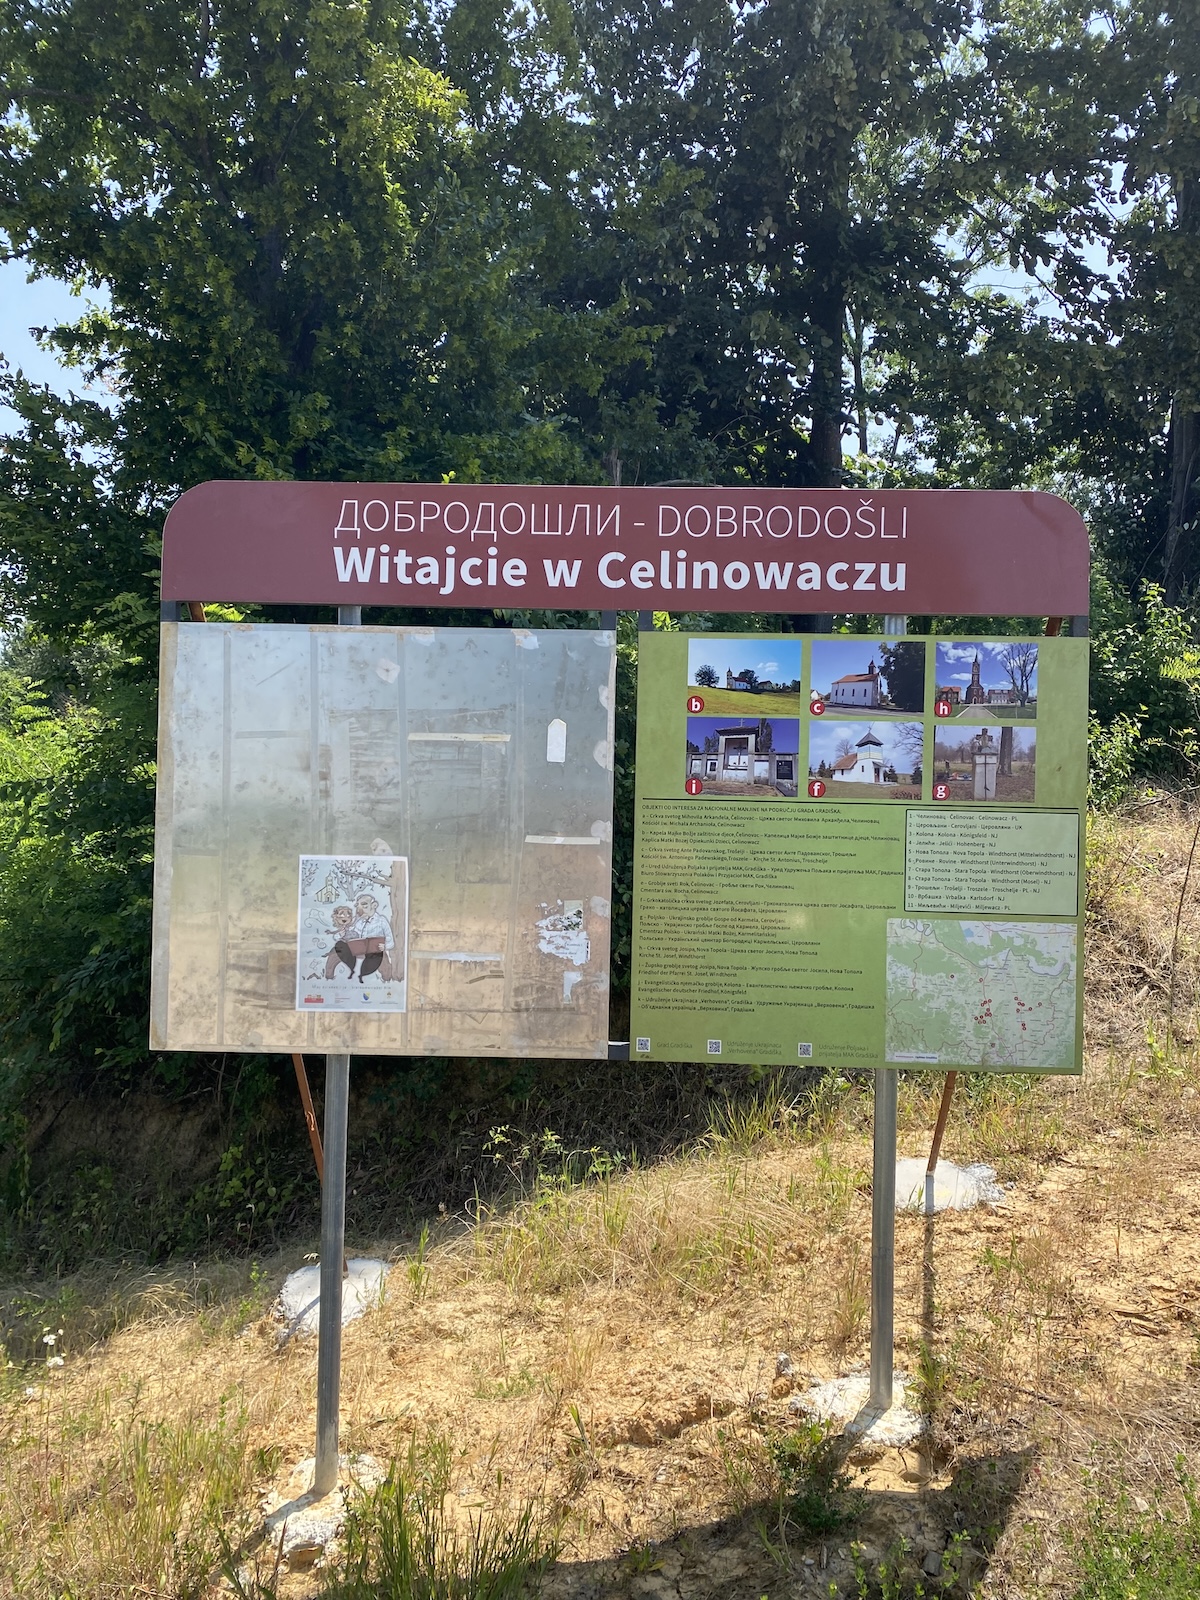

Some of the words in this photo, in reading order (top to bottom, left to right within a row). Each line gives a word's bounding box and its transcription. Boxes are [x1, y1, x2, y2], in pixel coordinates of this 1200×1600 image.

[334, 500, 620, 542] ДОБРОДОШЛИ
[658, 498, 907, 538] DOBRODOŠLI
[333, 544, 528, 595] Witajcie
[543, 559, 582, 588] w
[597, 550, 906, 592] Celinowaczu
[691, 699, 700, 710] b
[813, 703, 821, 713] c
[939, 703, 948, 714] h
[692, 781, 697, 792] i
[813, 782, 820, 795] f
[936, 786, 947, 797] g
